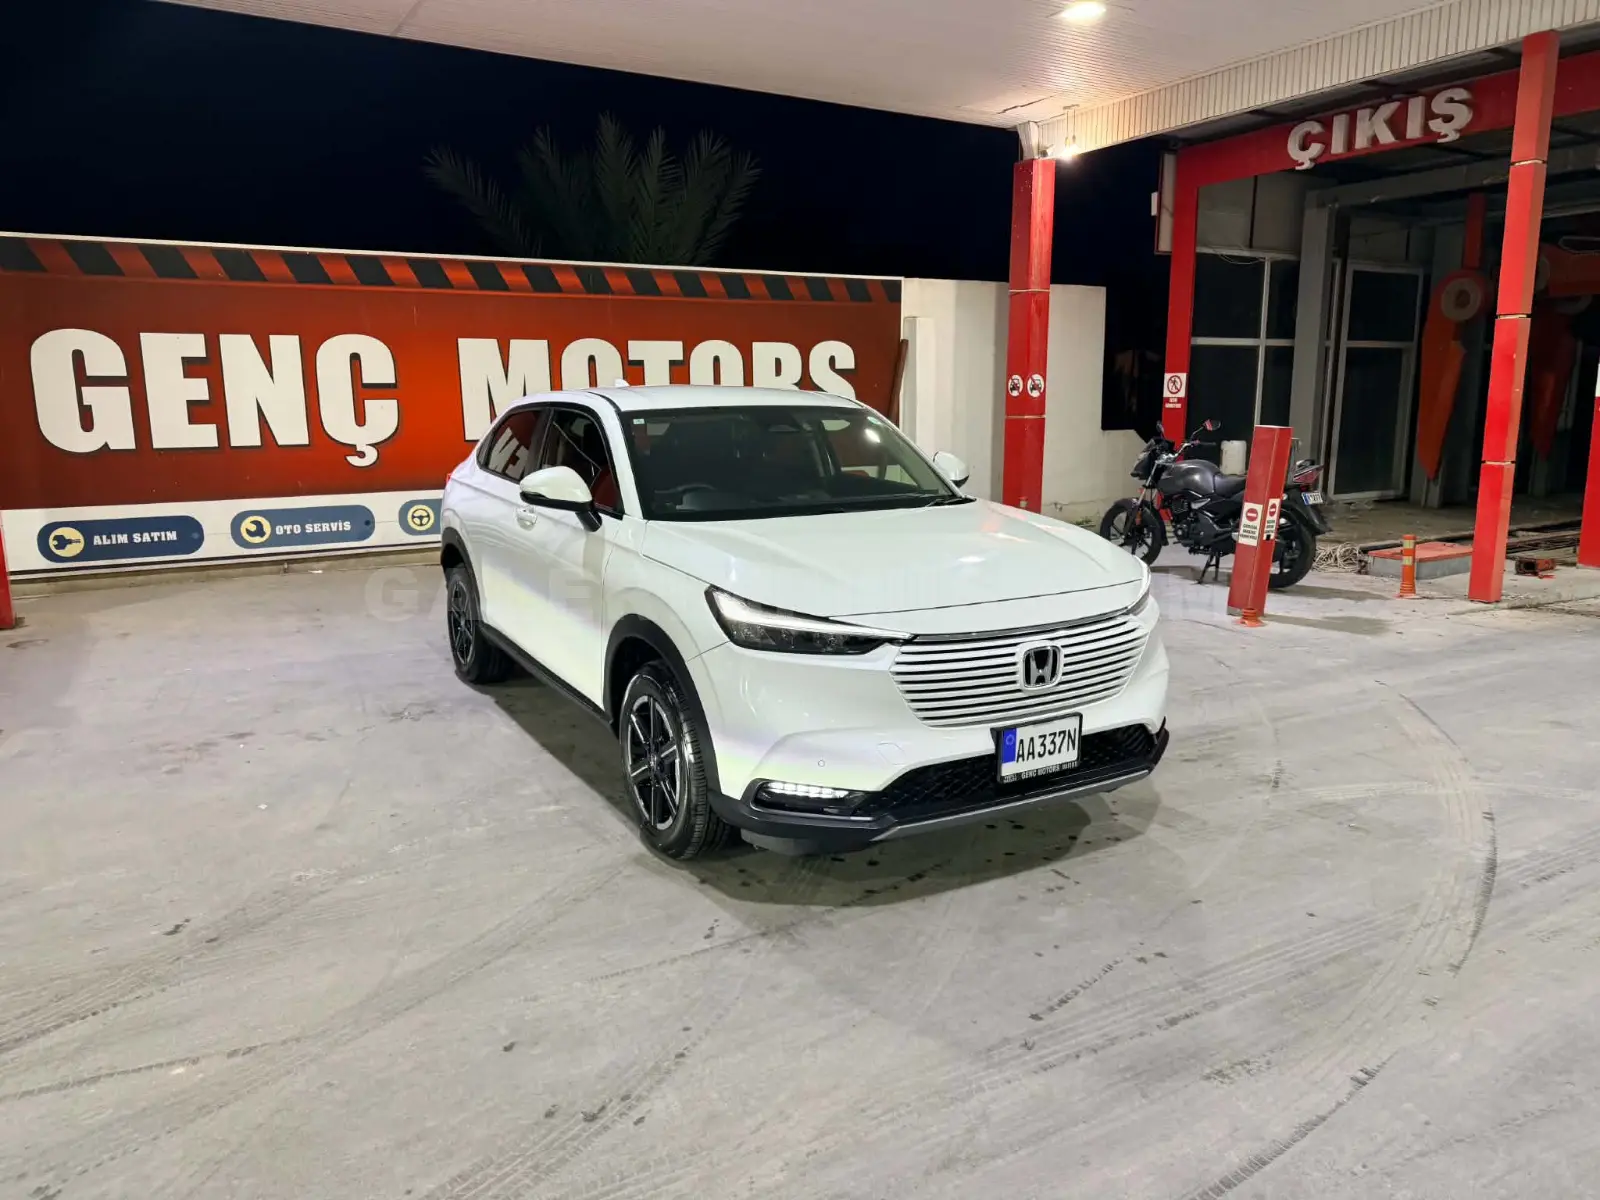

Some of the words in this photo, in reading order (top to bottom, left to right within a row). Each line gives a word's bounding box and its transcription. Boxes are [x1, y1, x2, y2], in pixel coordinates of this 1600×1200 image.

[1287, 87, 1473, 170] ÇIKIŞ
[30, 328, 399, 467] GENÇ
[93, 531, 129, 546] ALIM
[133, 530, 177, 543] SATIM
[275, 524, 302, 535] OTO
[305, 519, 351, 533] SERVİS
[1016, 728, 1077, 763] AA337N
